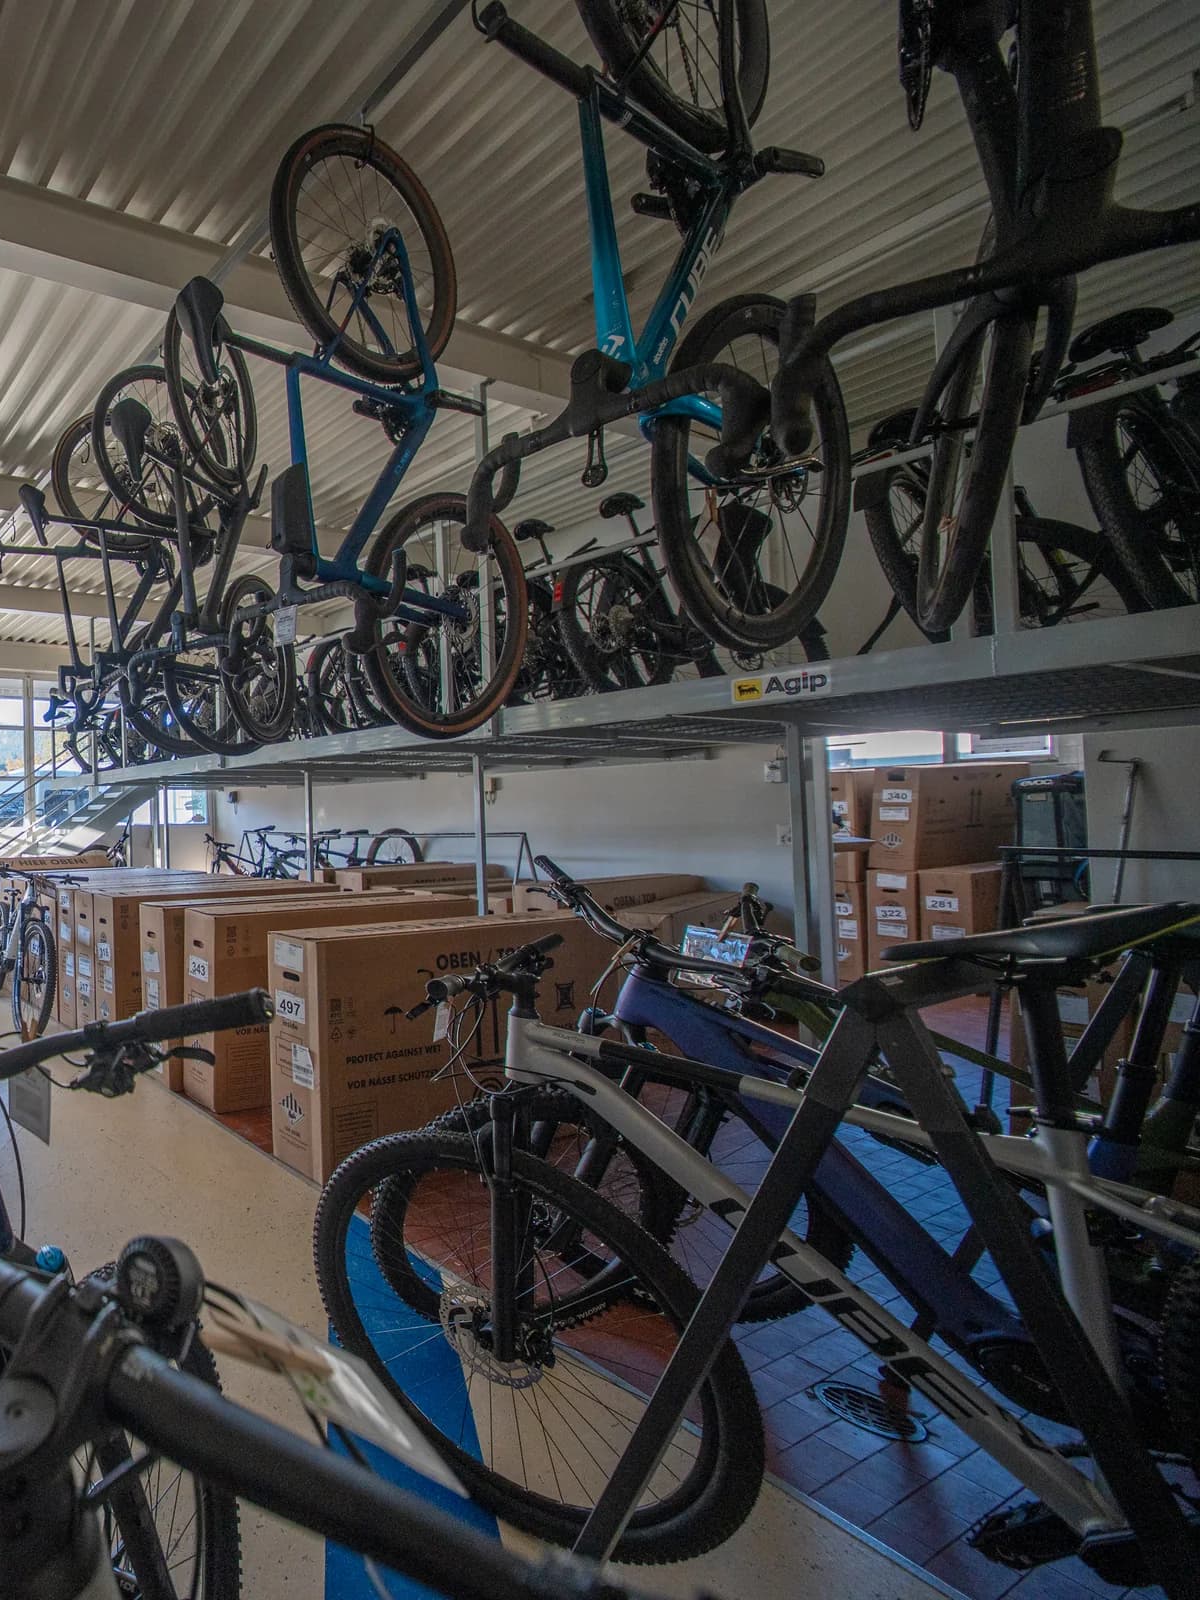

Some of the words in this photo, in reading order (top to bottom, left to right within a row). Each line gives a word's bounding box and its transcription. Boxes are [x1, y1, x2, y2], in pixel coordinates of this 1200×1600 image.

[764, 671, 828, 696] Agip
[887, 791, 908, 801] 340
[880, 908, 903, 918] 322
[930, 899, 953, 909] 281
[191, 961, 207, 977] 343
[436, 950, 482, 971] OBEN
[279, 998, 301, 1017] 497
[345, 1053, 383, 1065] PROTECT
[385, 1049, 423, 1060] AGAINST
[424, 1044, 441, 1055] WET
[347, 1079, 367, 1090] VOR
[398, 1068, 441, 1082] SCHÜTZE
